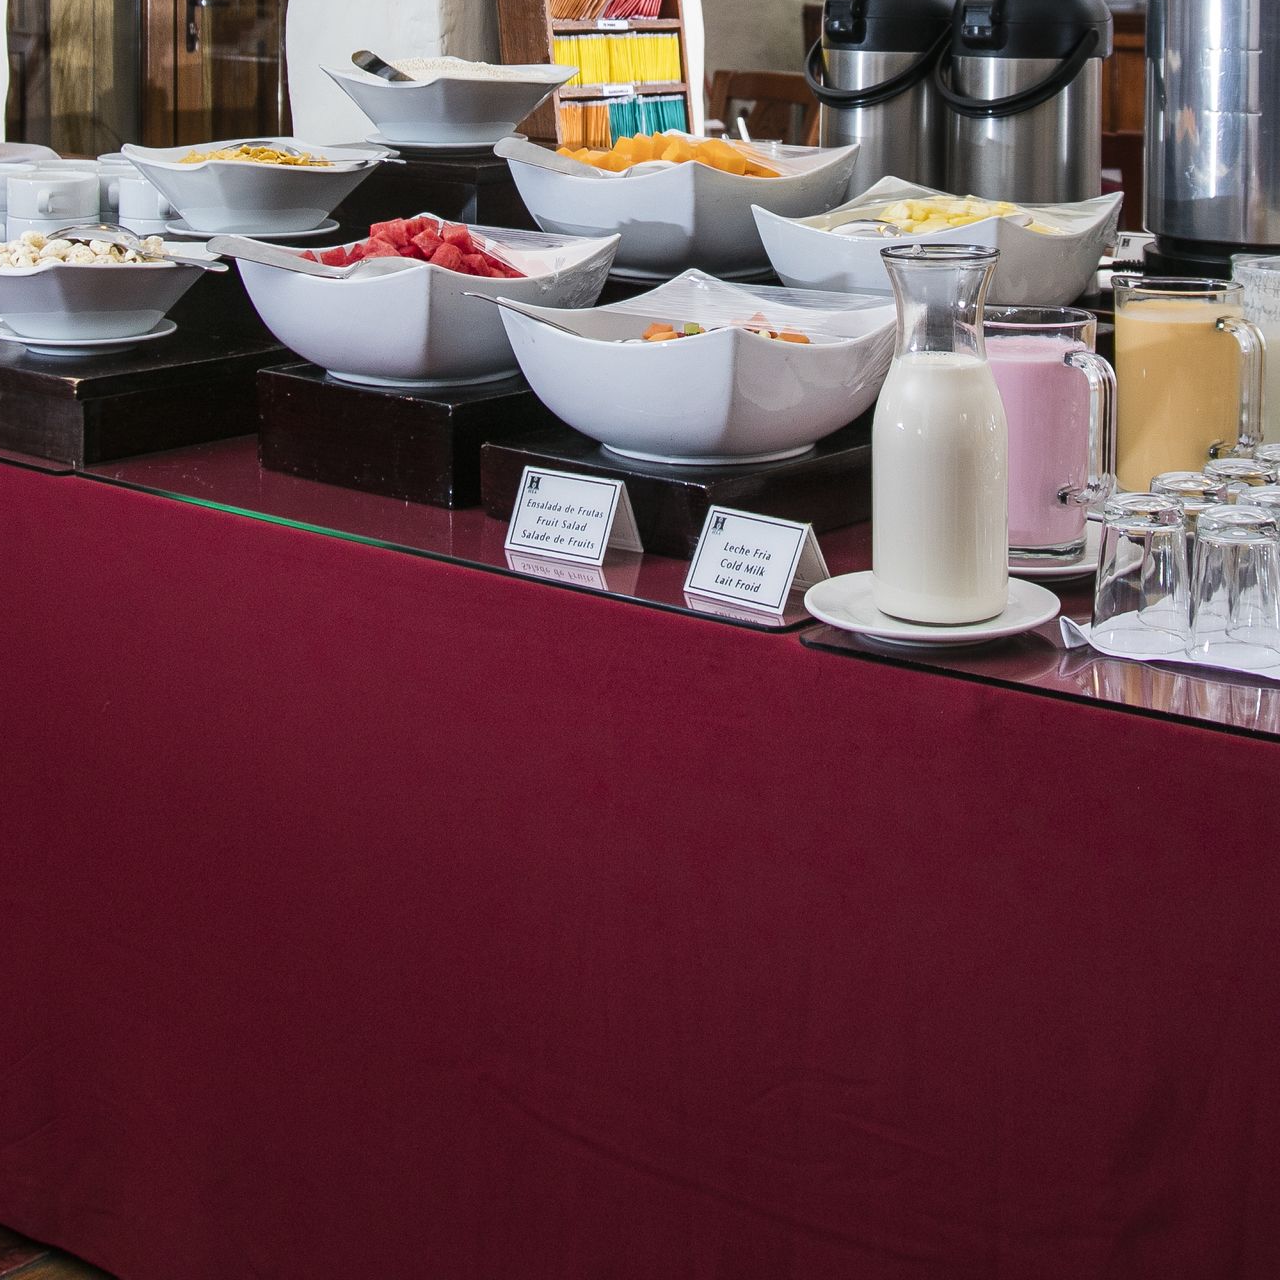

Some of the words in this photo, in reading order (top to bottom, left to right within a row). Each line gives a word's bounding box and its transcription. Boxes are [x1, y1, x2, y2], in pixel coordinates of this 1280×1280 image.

[526, 498, 562, 512] Ensalada
[564, 505, 575, 514] de
[577, 506, 604, 519] Frutas
[536, 516, 560, 528] Fruit
[561, 520, 588, 532] Salad
[521, 529, 551, 542] Salade
[553, 534, 565, 545] de
[568, 537, 595, 550] Fruits
[723, 542, 751, 557] Leche
[753, 548, 772, 561] Fria
[720, 558, 742, 572] Cold
[744, 564, 766, 577] Milk
[714, 574, 733, 586] Lait
[735, 579, 762, 593] Froid
